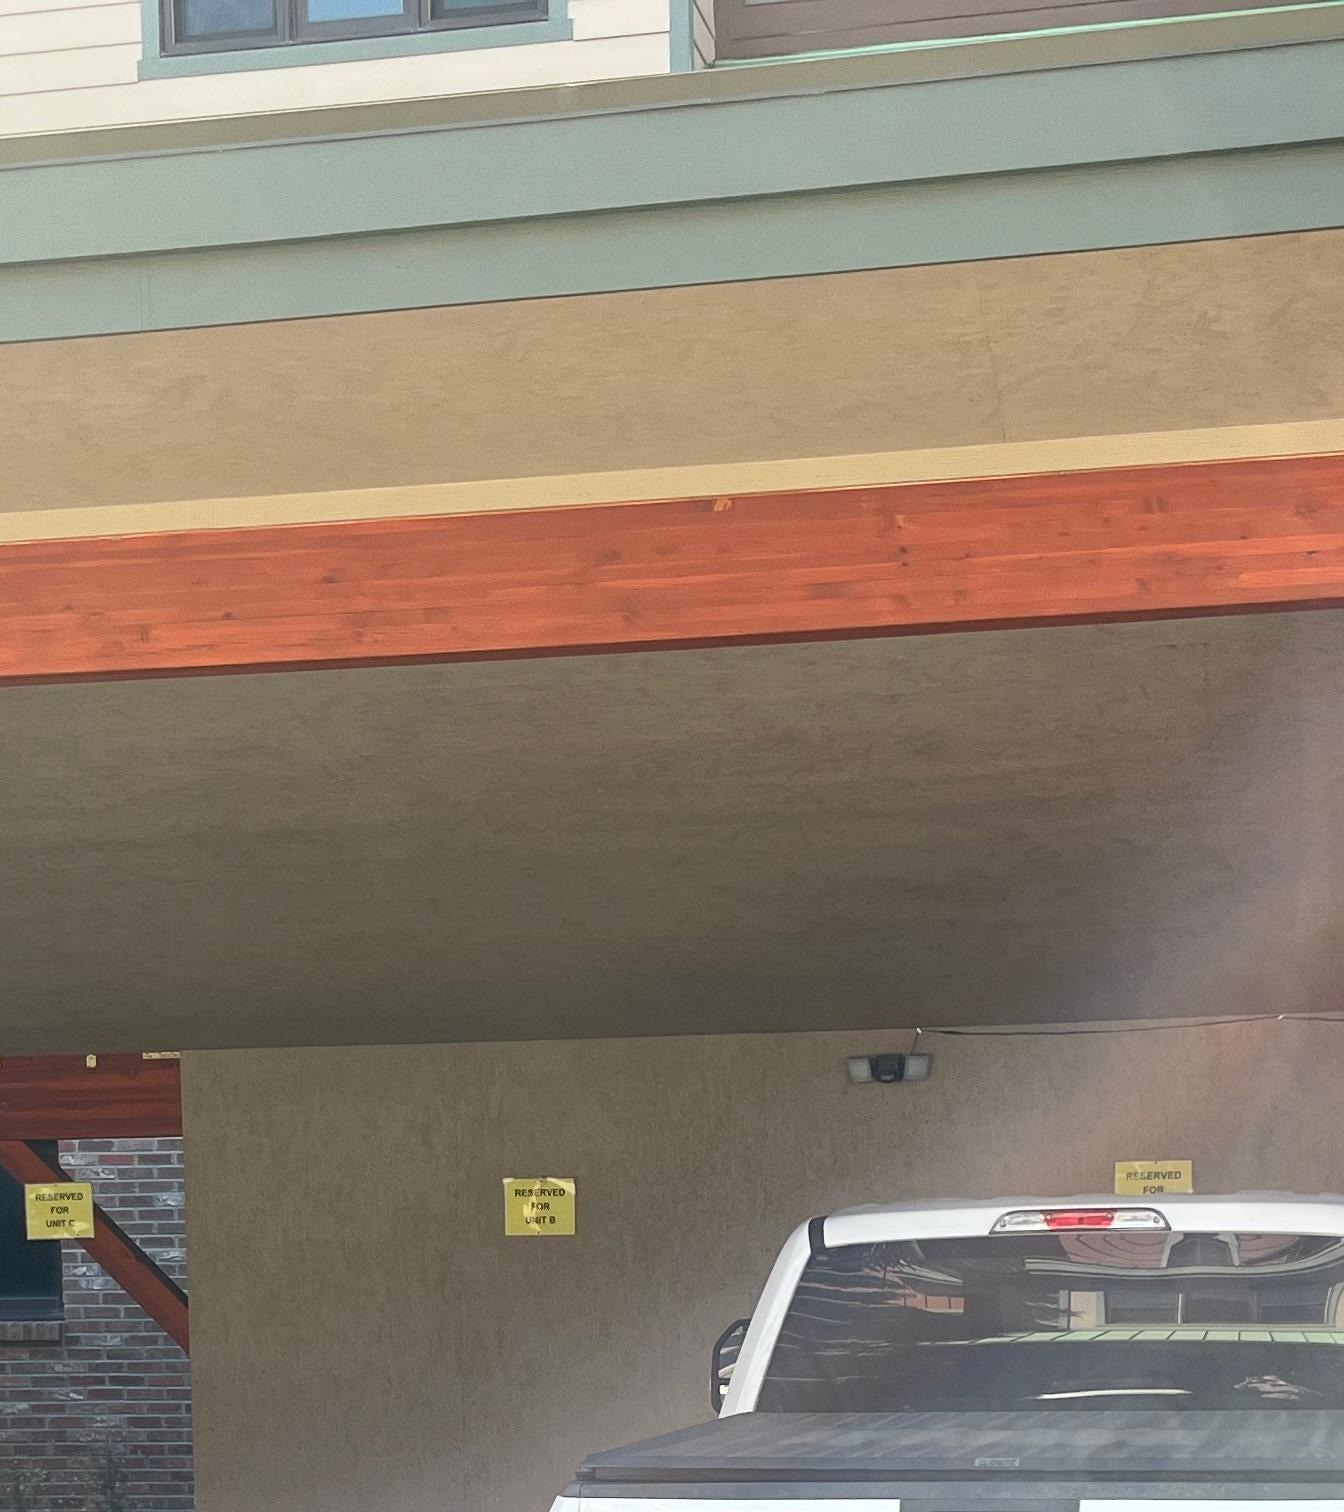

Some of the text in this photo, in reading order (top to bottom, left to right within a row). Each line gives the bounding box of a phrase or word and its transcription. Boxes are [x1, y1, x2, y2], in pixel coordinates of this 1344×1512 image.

[1126, 1171, 1182, 1181] RESERVED
[514, 1189, 566, 1197] RESERVED
[1143, 1186, 1164, 1194] FOR
[35, 1192, 84, 1201] RESERVED
[50, 1206, 69, 1215] FOR
[46, 1220, 66, 1228] UNIT
[549, 1216, 556, 1224] B
